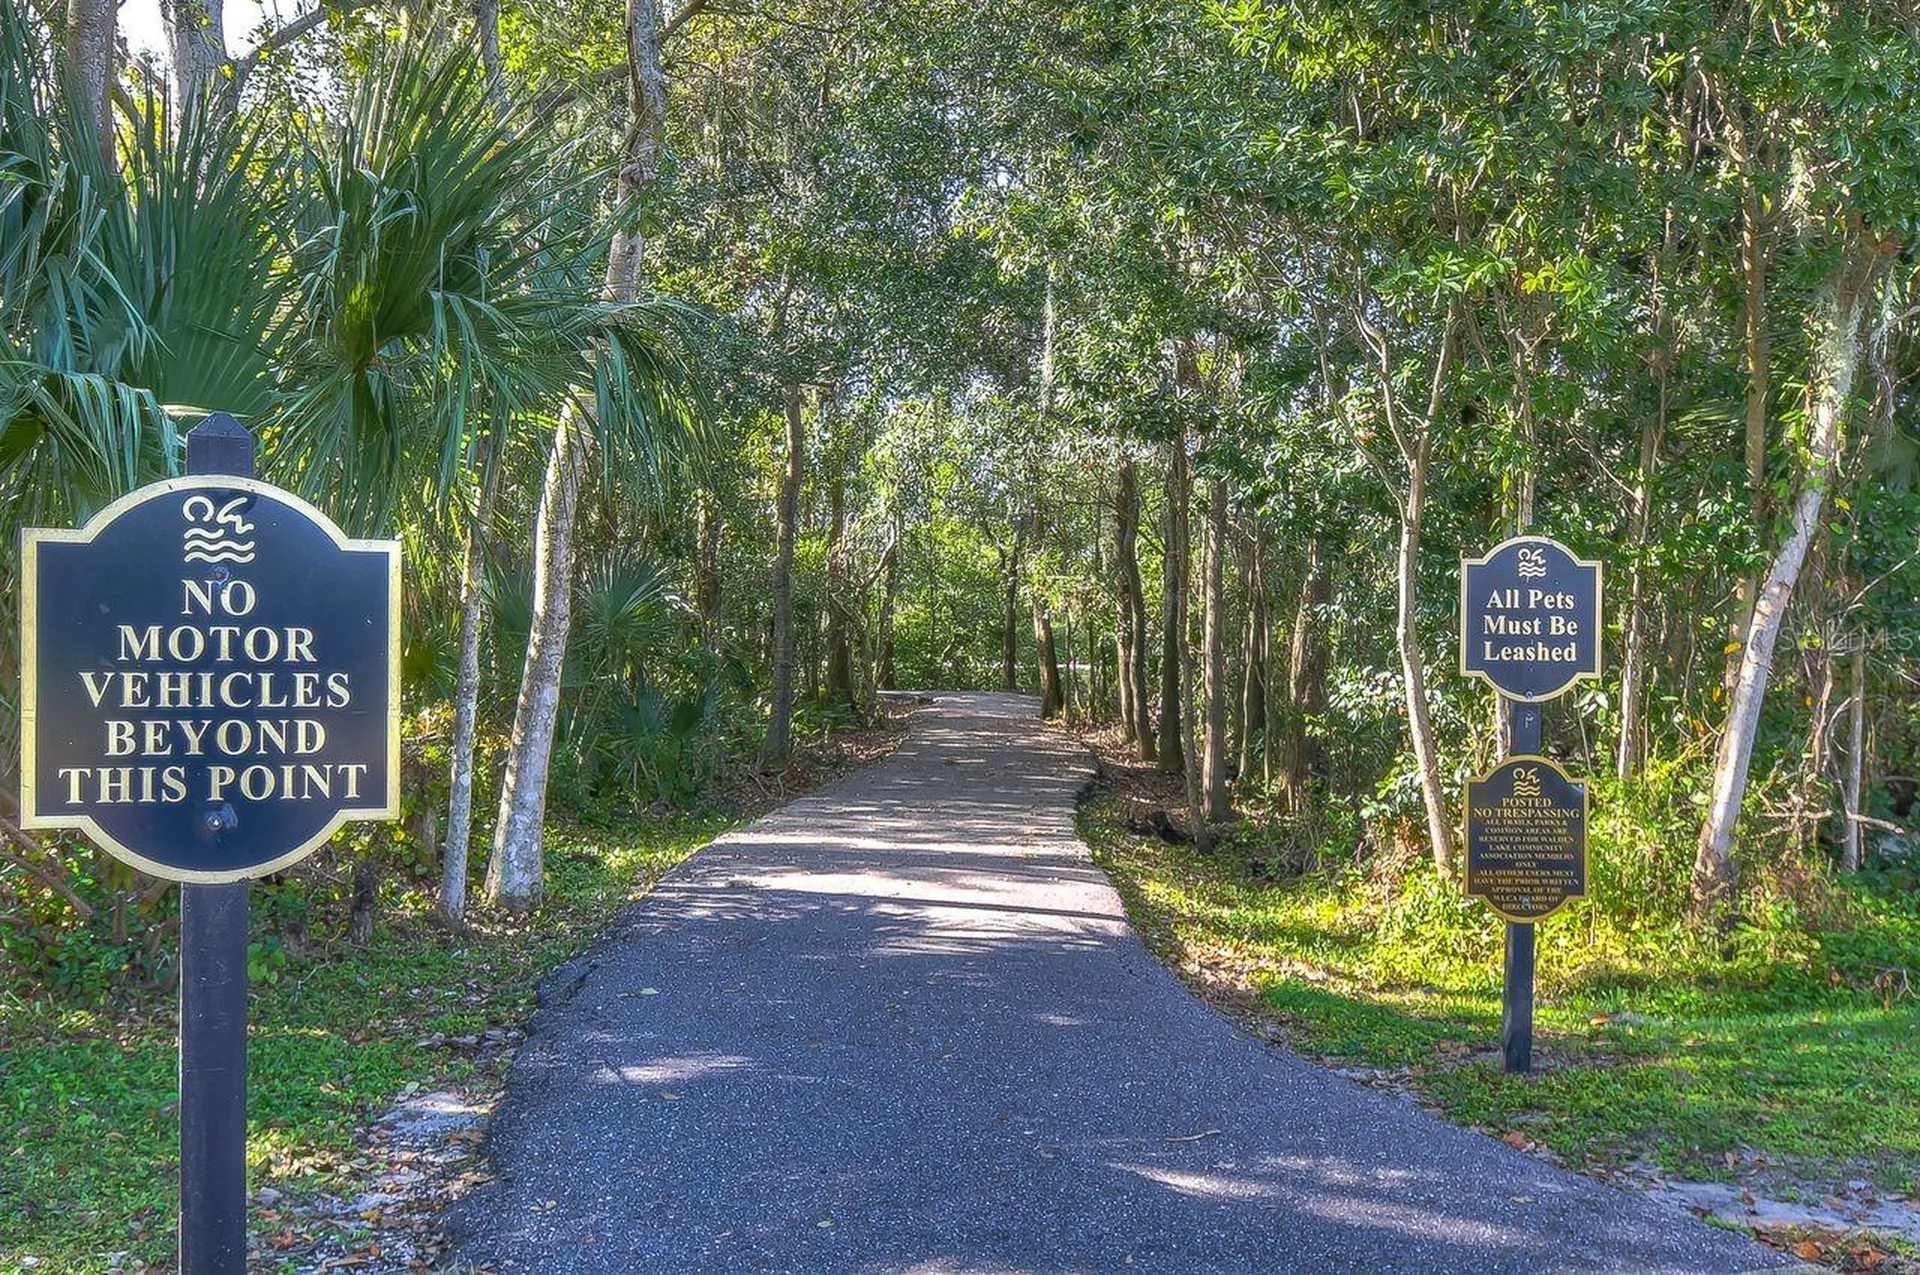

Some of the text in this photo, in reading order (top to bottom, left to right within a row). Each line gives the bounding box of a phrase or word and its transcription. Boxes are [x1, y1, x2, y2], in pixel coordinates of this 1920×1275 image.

[181, 579, 256, 616] NO
[1486, 590, 1575, 610] All Pets
[1483, 615, 1578, 636] Must Be
[118, 625, 317, 662] MOTOR
[1483, 641, 1577, 662] Leashed
[78, 672, 351, 709] VEHICLES
[104, 719, 326, 756] BEYOND
[58, 764, 368, 804] THIS POINT
[1502, 797, 1552, 807] POSTED
[1473, 808, 1580, 818] NO TRESPASSING
[1478, 835, 1521, 843] RESERVED
[1551, 869, 1575, 877] MUST
